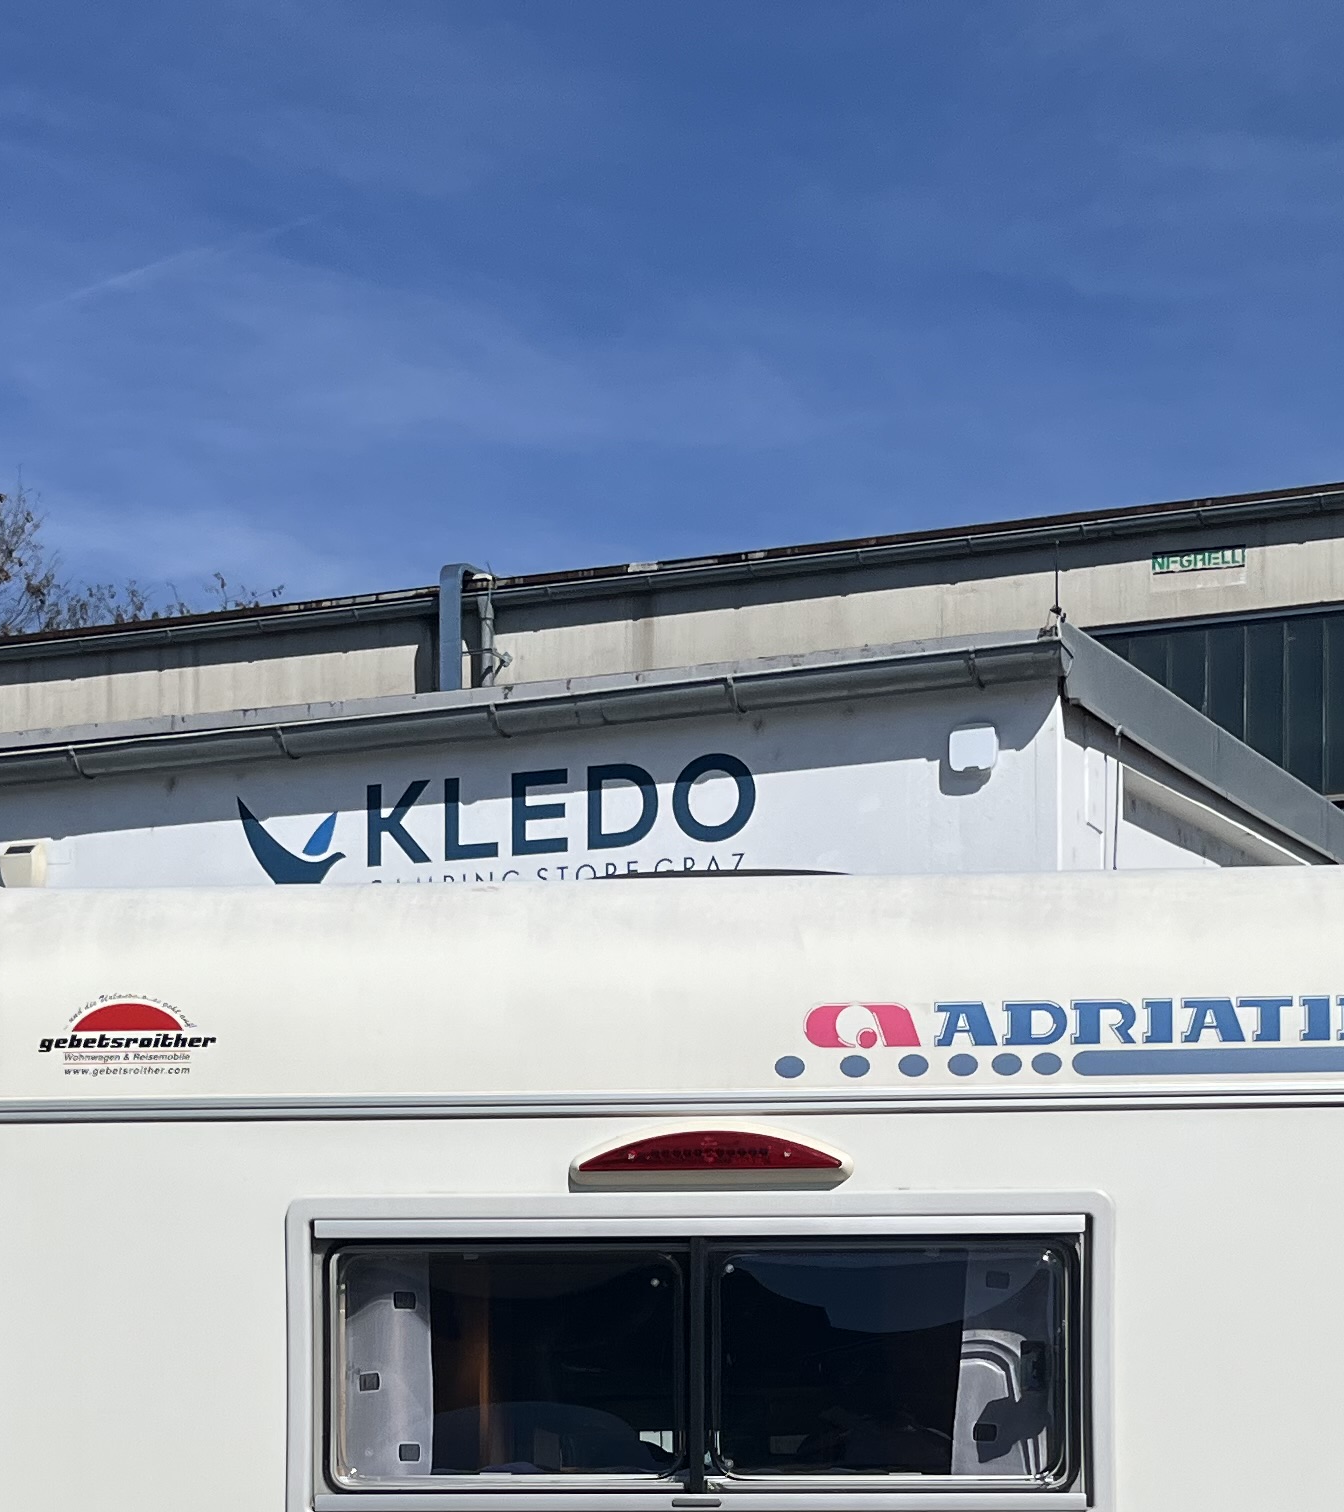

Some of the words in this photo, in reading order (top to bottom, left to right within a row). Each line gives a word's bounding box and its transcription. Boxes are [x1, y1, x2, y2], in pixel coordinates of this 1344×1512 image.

[366, 752, 757, 867] KLEDO
[38, 1033, 217, 1052] gebetsroither
[64, 1053, 121, 1064] Wohnwagen
[133, 1053, 191, 1061] Reisemobile
